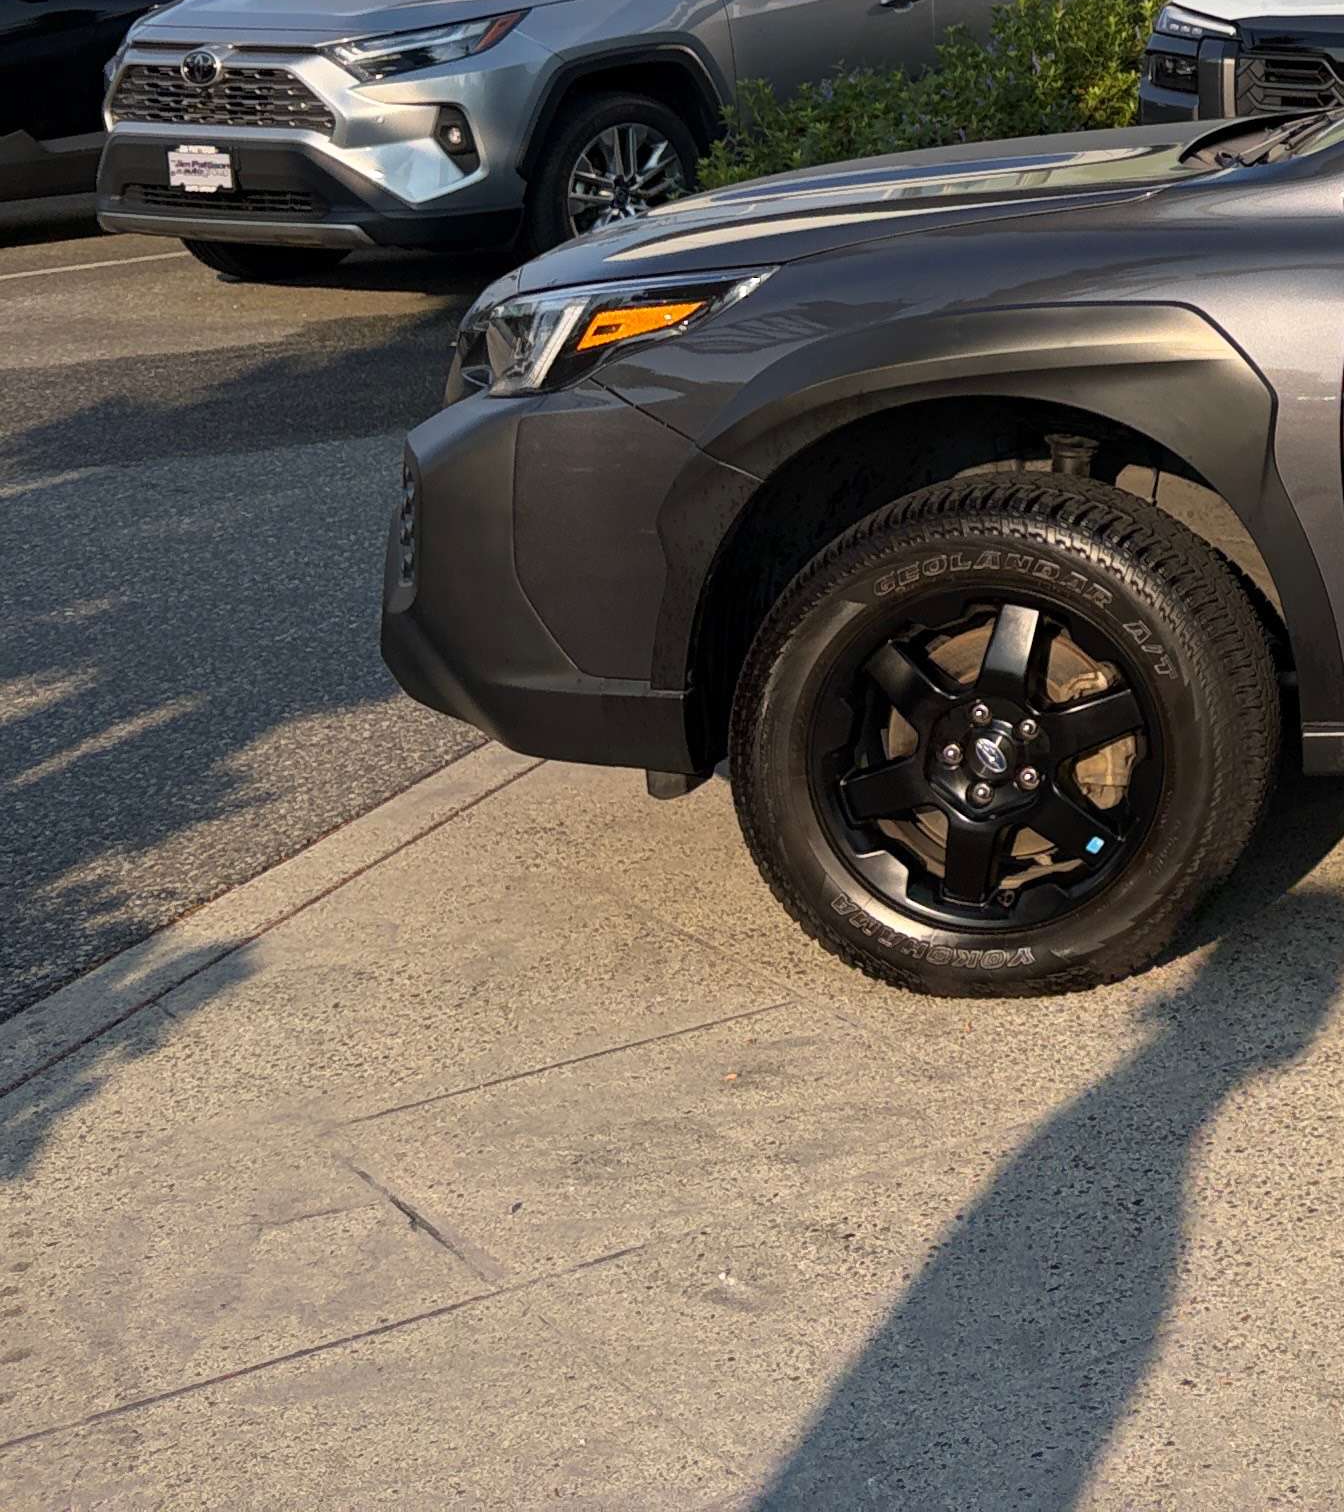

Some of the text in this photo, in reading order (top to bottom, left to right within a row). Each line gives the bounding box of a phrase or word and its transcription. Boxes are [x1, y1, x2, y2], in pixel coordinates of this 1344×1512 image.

[873, 550, 1178, 680] GEOLANDAR A/T
[831, 893, 1035, 970] YOKOHAMA
